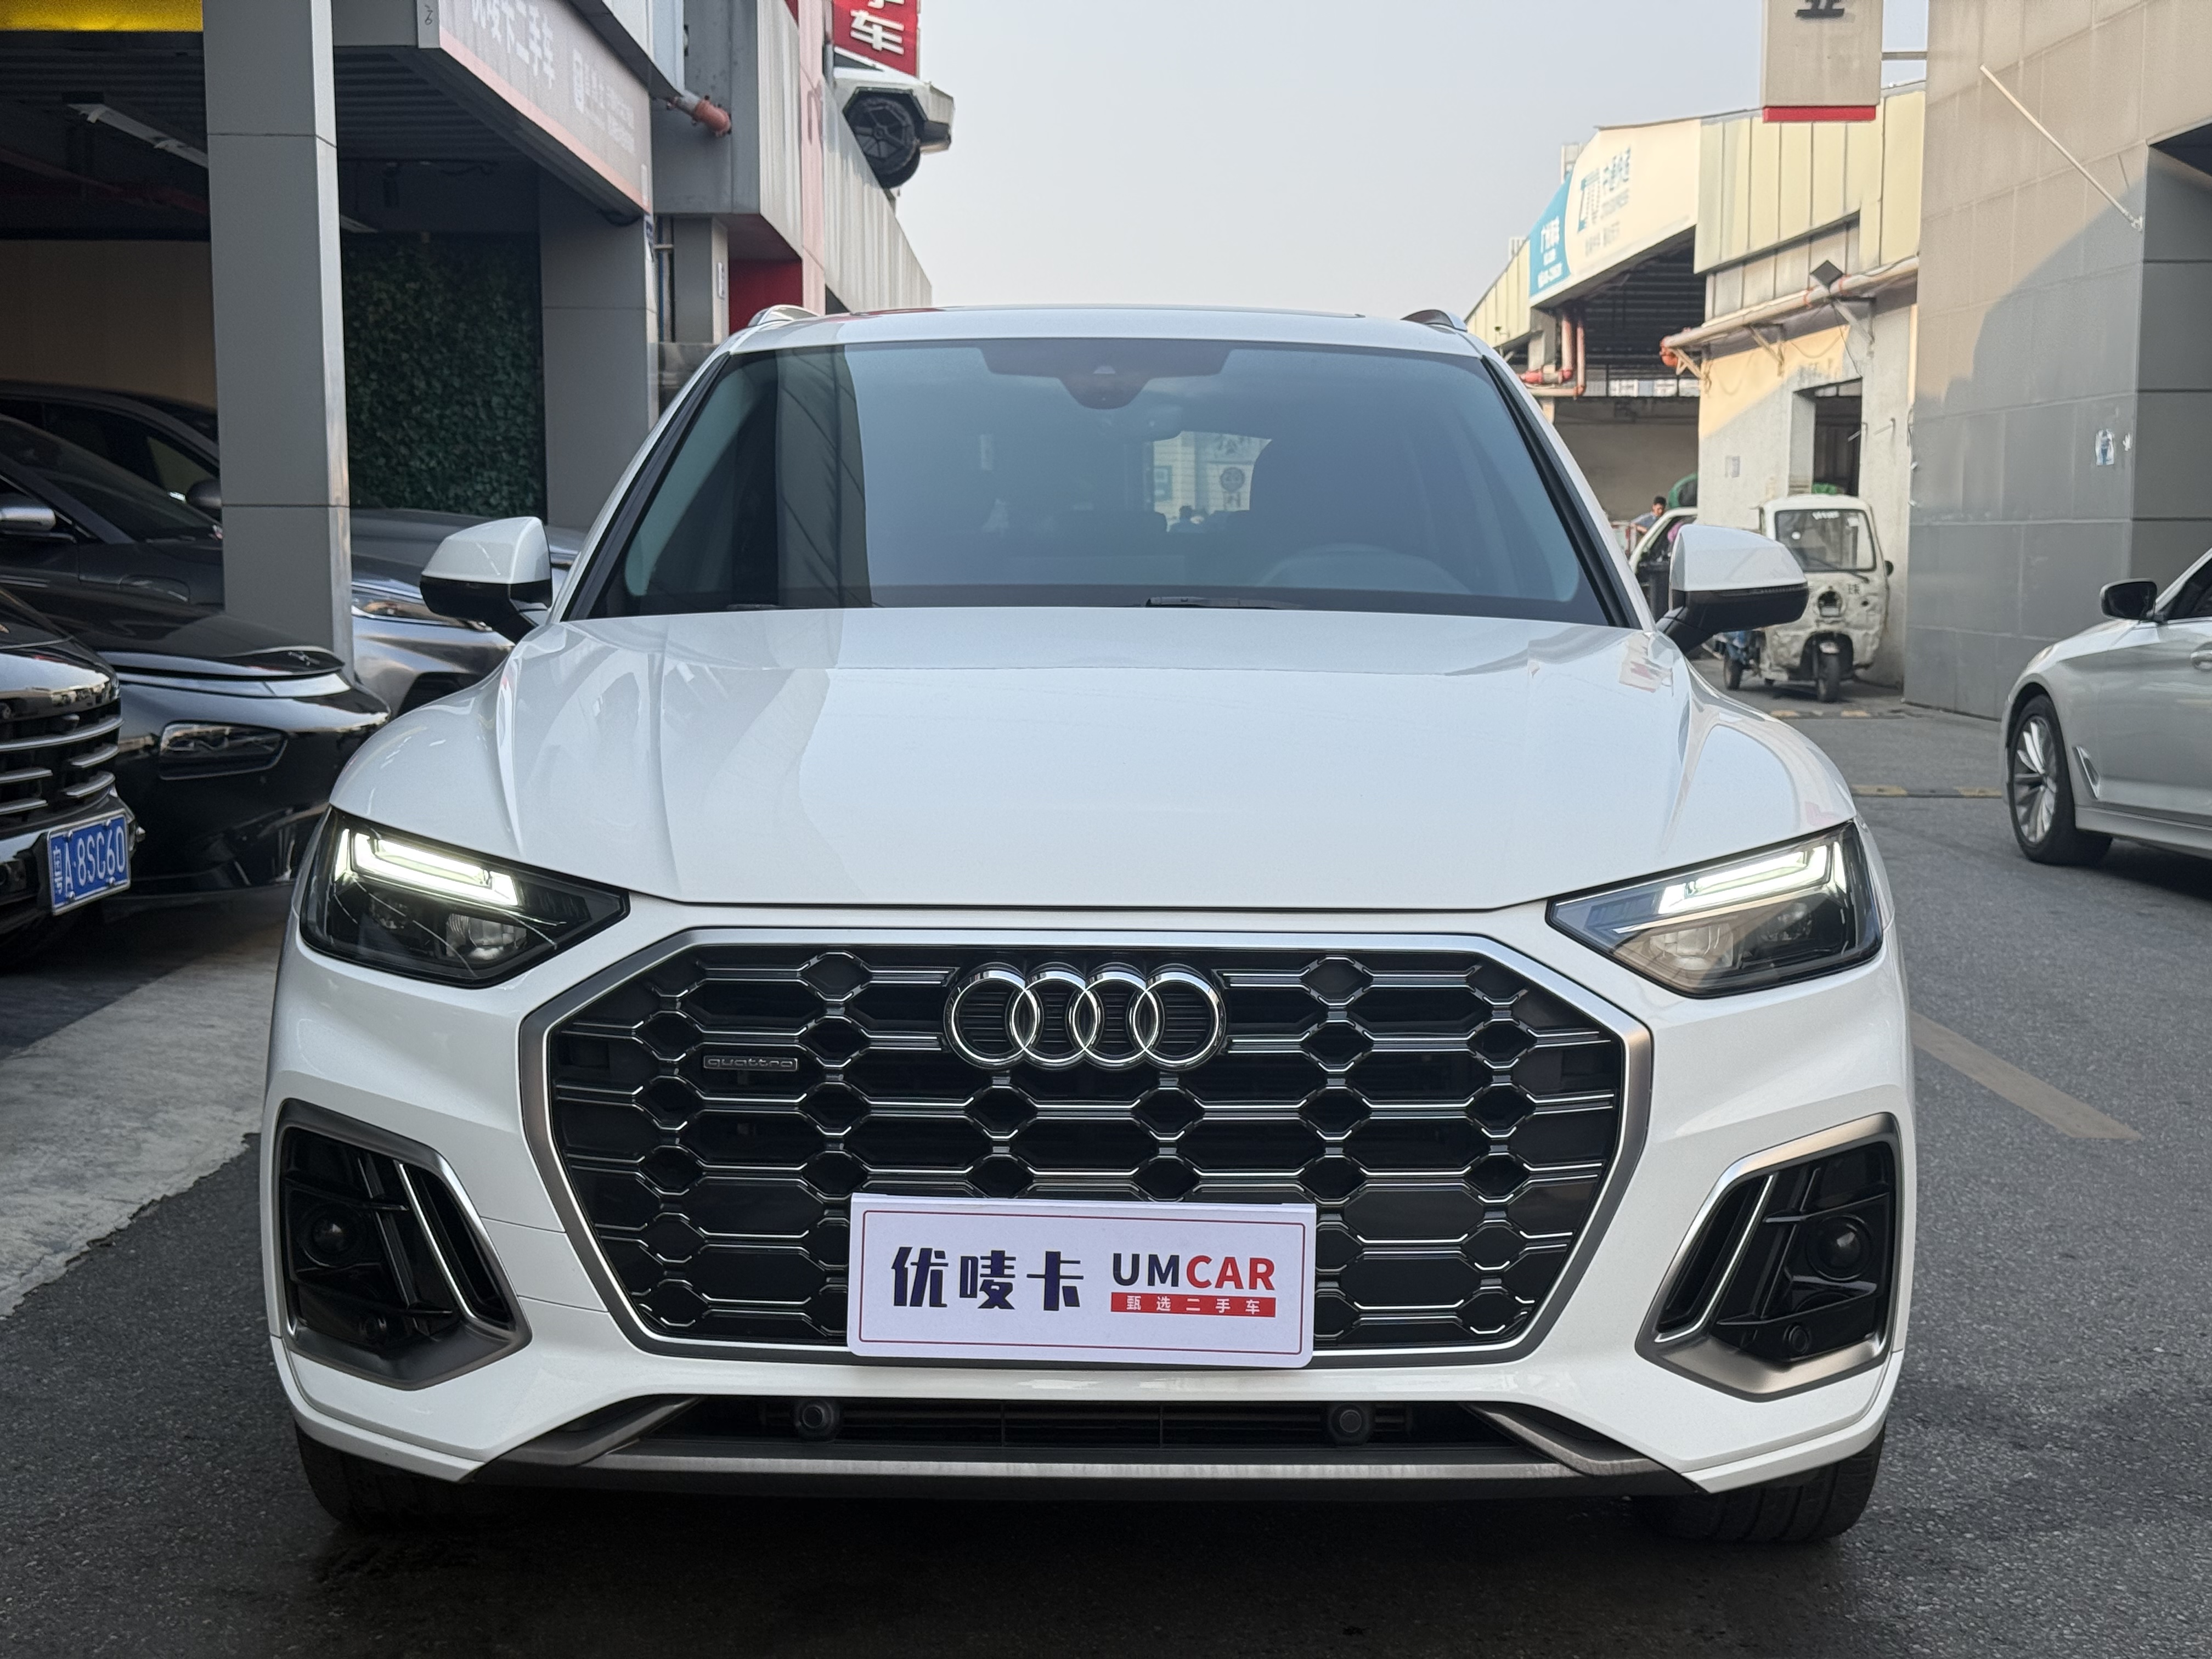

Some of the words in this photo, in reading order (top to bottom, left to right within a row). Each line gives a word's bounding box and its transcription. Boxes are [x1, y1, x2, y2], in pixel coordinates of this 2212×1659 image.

[850, 0, 905, 55] 车
[707, 1058, 793, 1068] quattro
[891, 1246, 1084, 1311] 优唛卡
[1112, 1253, 1275, 1290] UMCAR
[1126, 1295, 1261, 1315] 甄选二手车
